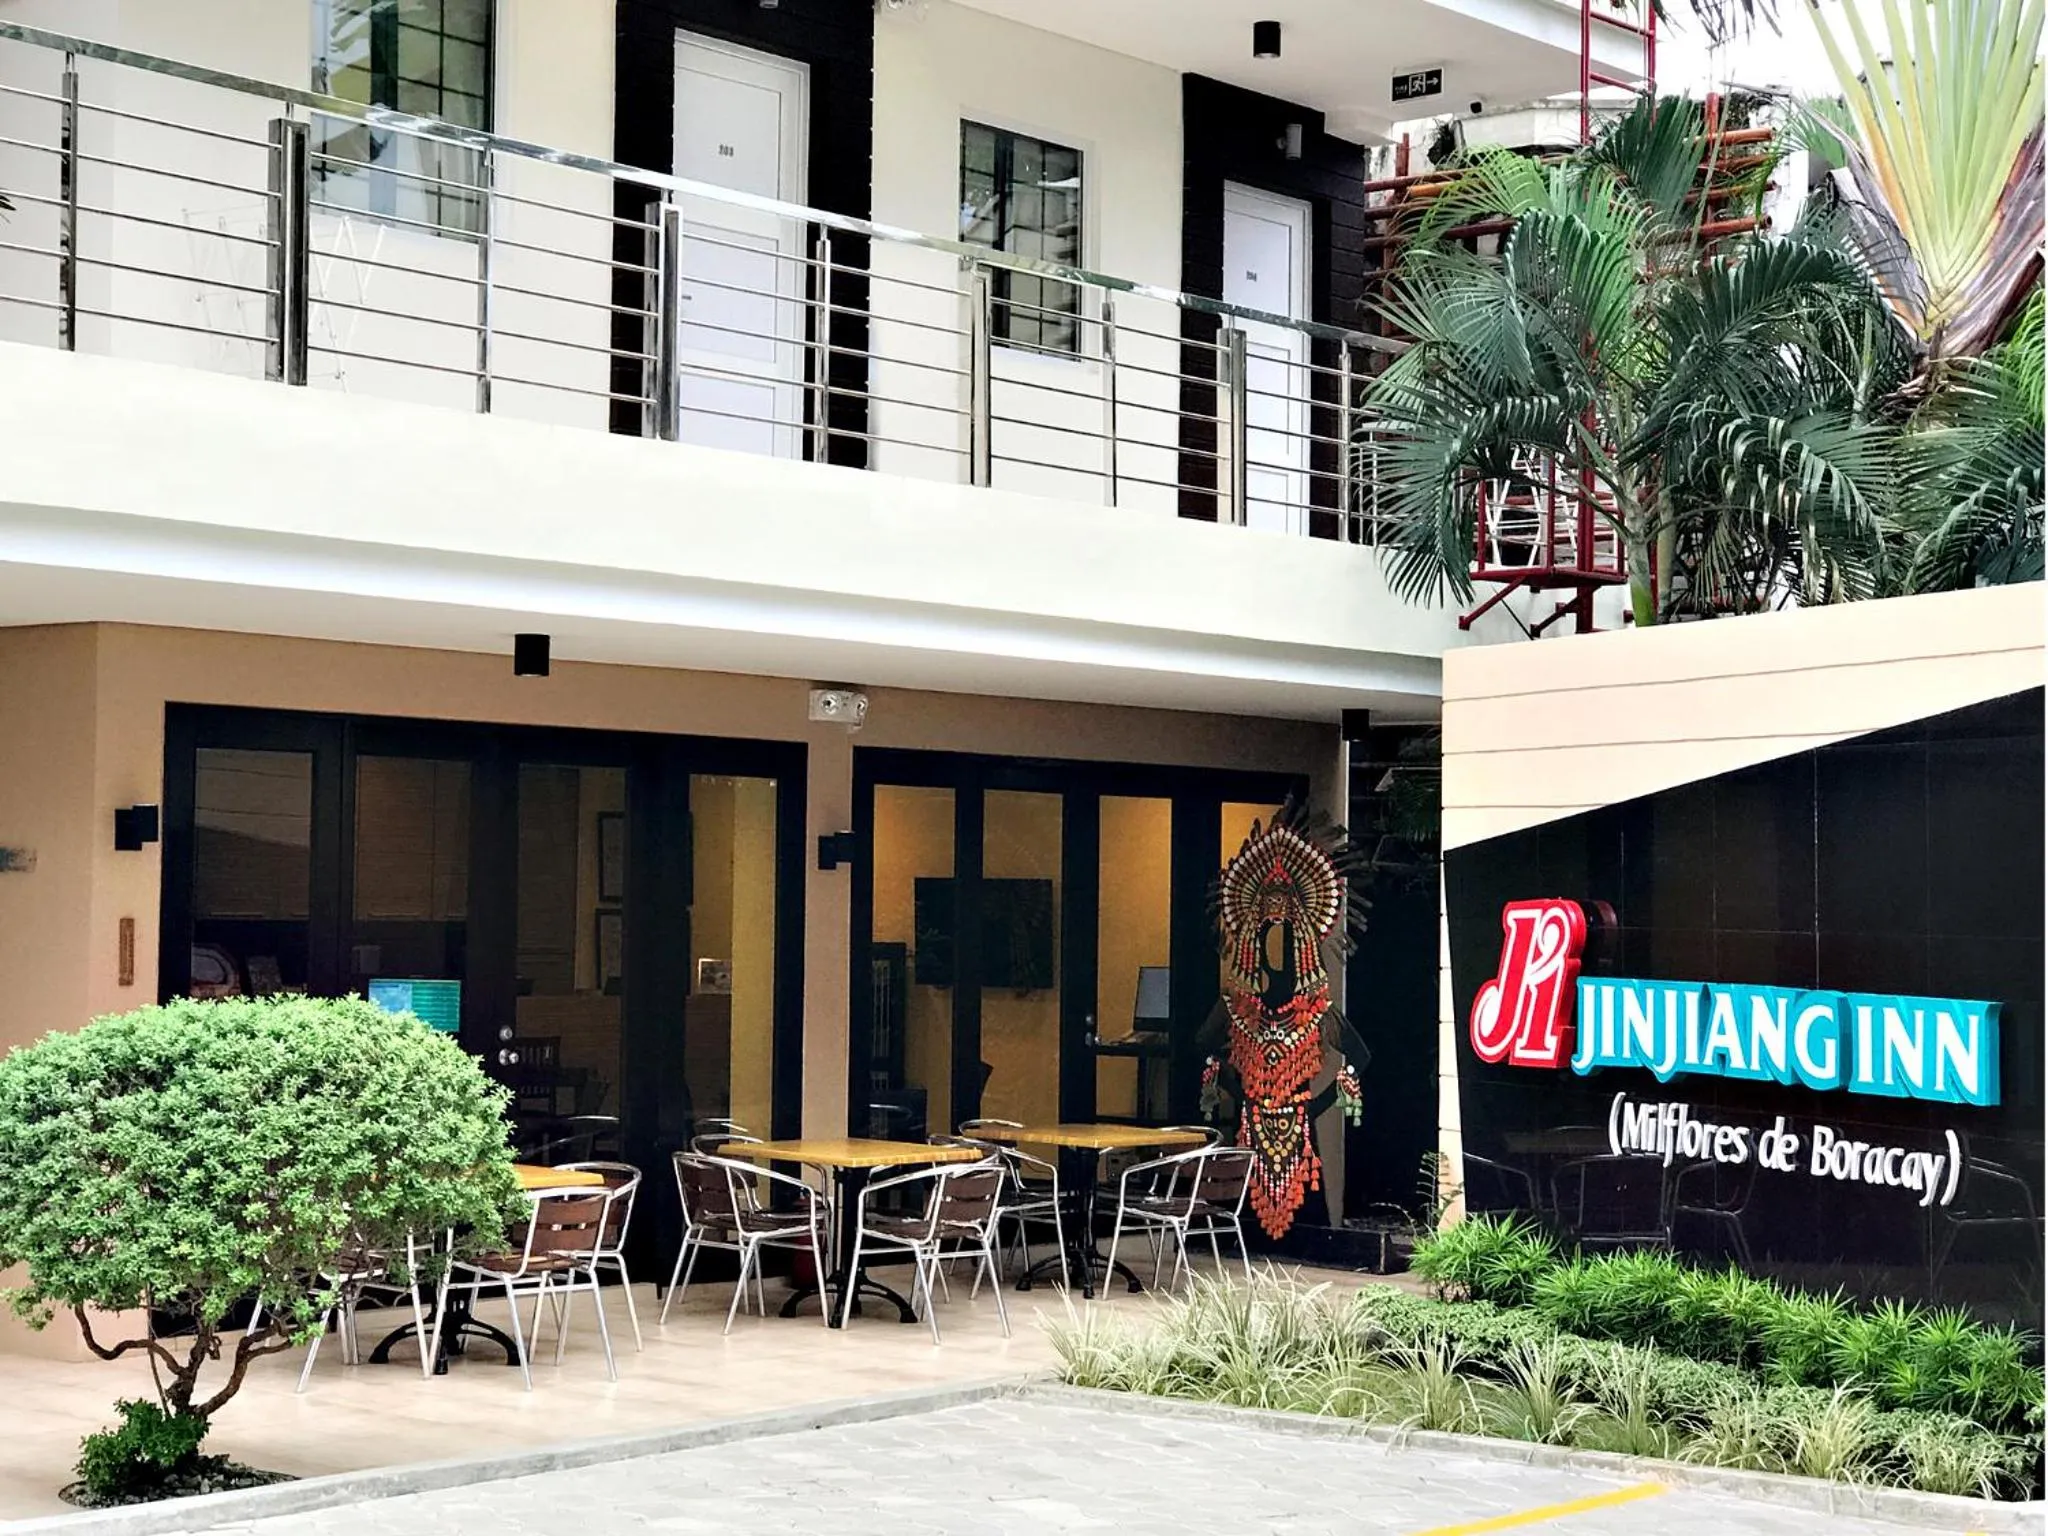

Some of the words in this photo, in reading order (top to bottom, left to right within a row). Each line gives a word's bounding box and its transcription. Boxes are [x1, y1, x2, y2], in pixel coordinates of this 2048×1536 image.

[1571, 980, 1842, 1083] JINJIANG
[1853, 1000, 1984, 1099] INN
[1608, 1091, 1750, 1169] (Milflores
[1758, 1115, 1799, 1173] de
[1809, 1125, 1963, 1207] Boracay)
